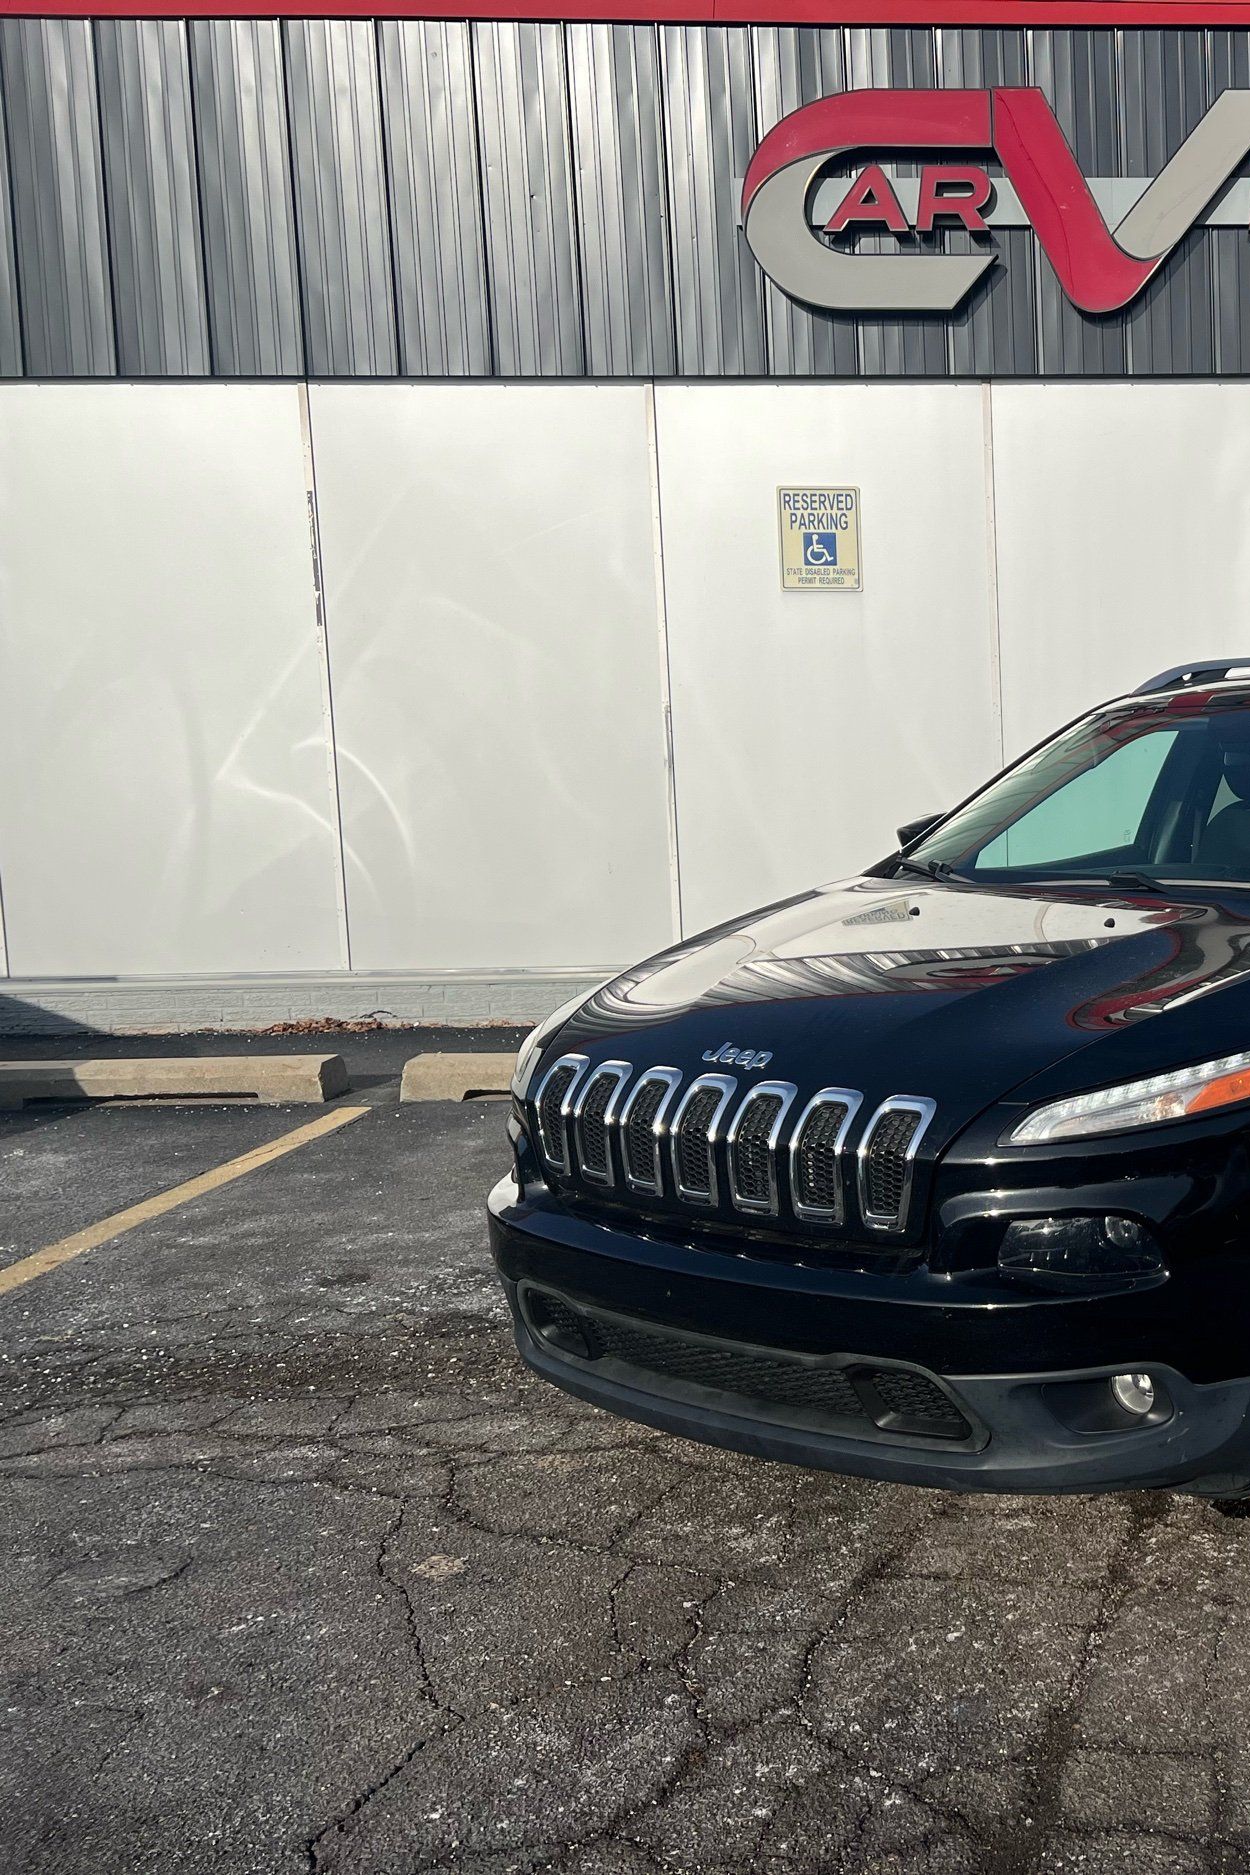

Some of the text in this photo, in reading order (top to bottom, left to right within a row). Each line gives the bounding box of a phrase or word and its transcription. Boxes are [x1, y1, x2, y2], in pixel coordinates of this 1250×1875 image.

[783, 493, 854, 511] RESERVED
[790, 512, 849, 530] PARKING
[786, 568, 856, 576] STATE DISABLED PARKING
[798, 577, 845, 585] PERMIT REQUIRED
[702, 1042, 773, 1070] Jeep
